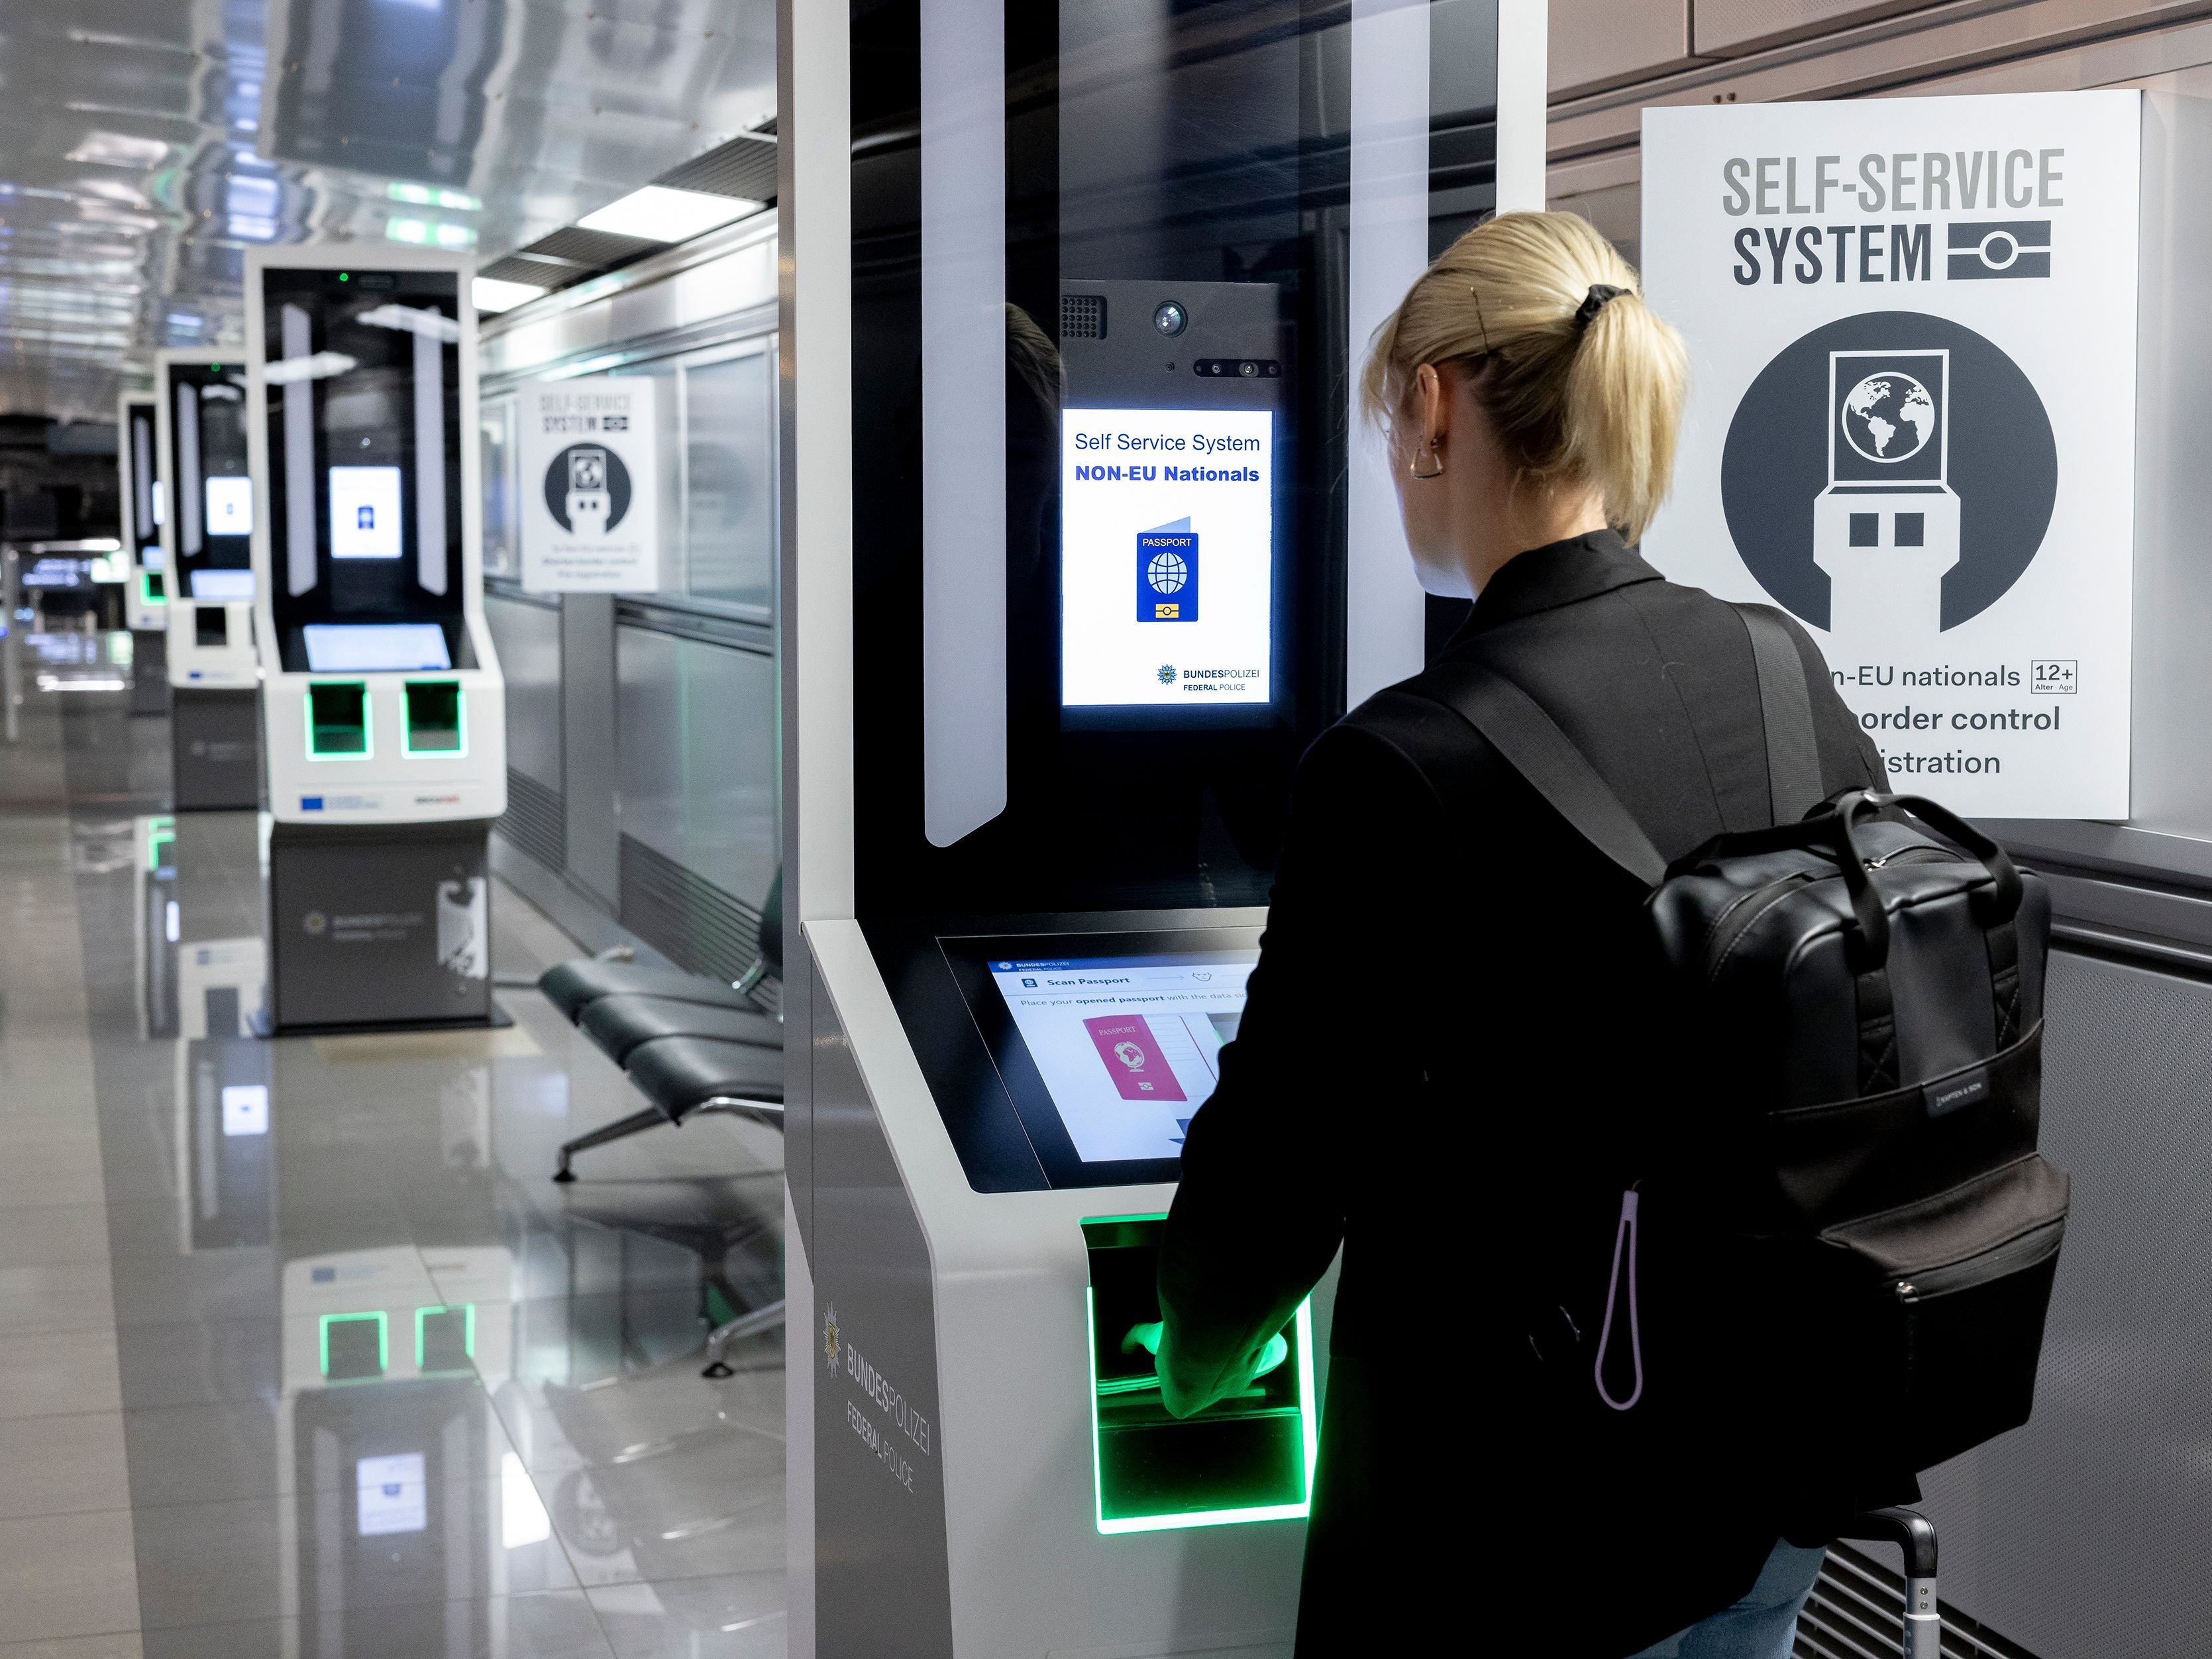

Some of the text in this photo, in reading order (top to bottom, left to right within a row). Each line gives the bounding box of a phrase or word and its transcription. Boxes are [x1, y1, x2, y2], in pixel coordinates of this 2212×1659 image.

[1722, 148, 2064, 216] SELF-SERVICE
[1733, 223, 1931, 285] SYSTEM
[1075, 433, 1259, 455] Self Service System
[1076, 466, 1259, 482] NON-EU Nationals
[1143, 538, 1192, 547] PASSPORT
[1183, 669, 1259, 678] BUNDESPOLIZEI
[1831, 665, 2021, 686] n-EU nationals
[2036, 665, 2073, 680] 12+
[1861, 706, 2060, 730] order control
[1880, 749, 2000, 774] istration
[1079, 977, 1130, 987] Passport
[1119, 996, 1165, 1004] passport
[1098, 1026, 1136, 1035] PASSPORT
[847, 1342, 929, 1456] BUNDESPOLIZEI
[847, 1399, 914, 1493] FEDERAL POLICE
